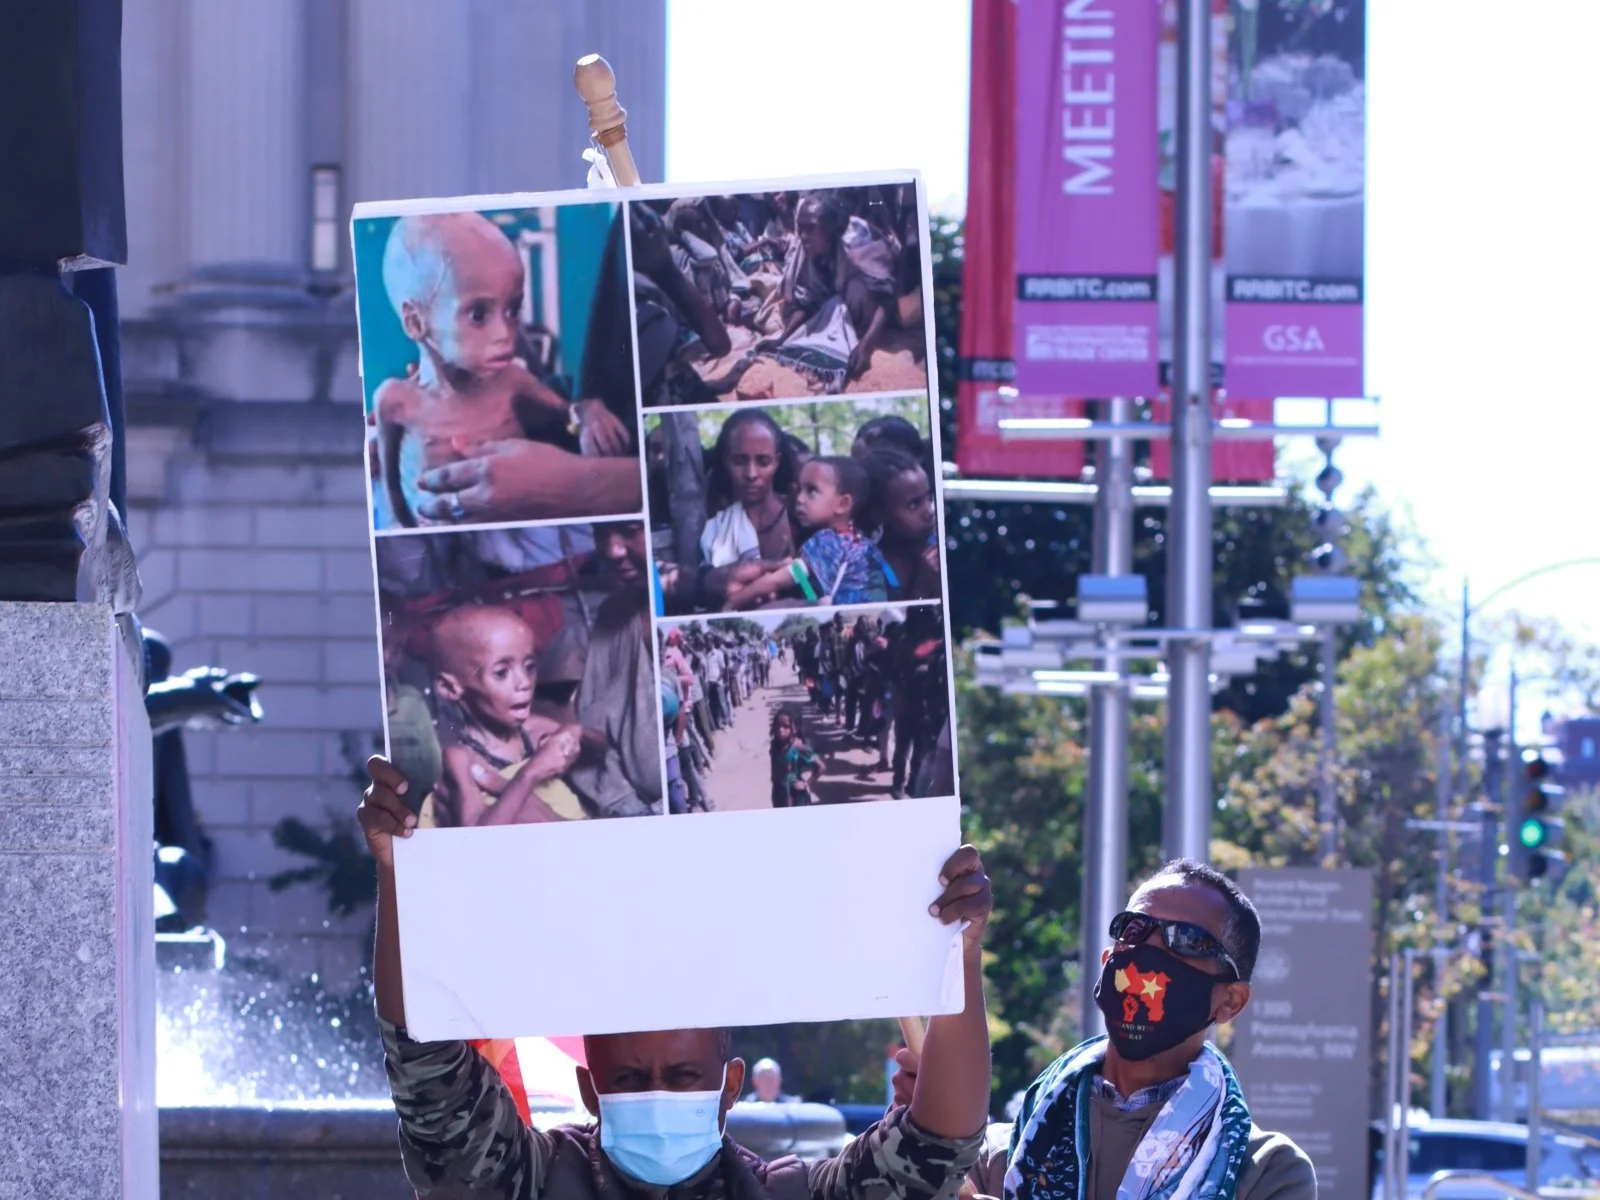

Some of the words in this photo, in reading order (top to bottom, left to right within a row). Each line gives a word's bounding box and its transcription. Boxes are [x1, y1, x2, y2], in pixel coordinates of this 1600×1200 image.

[1263, 324, 1325, 352] GSA
[1250, 1019, 1358, 1042] Pennsylvania
[1250, 1041, 1319, 1061] Avenue,
[1323, 1041, 1356, 1060] NW
